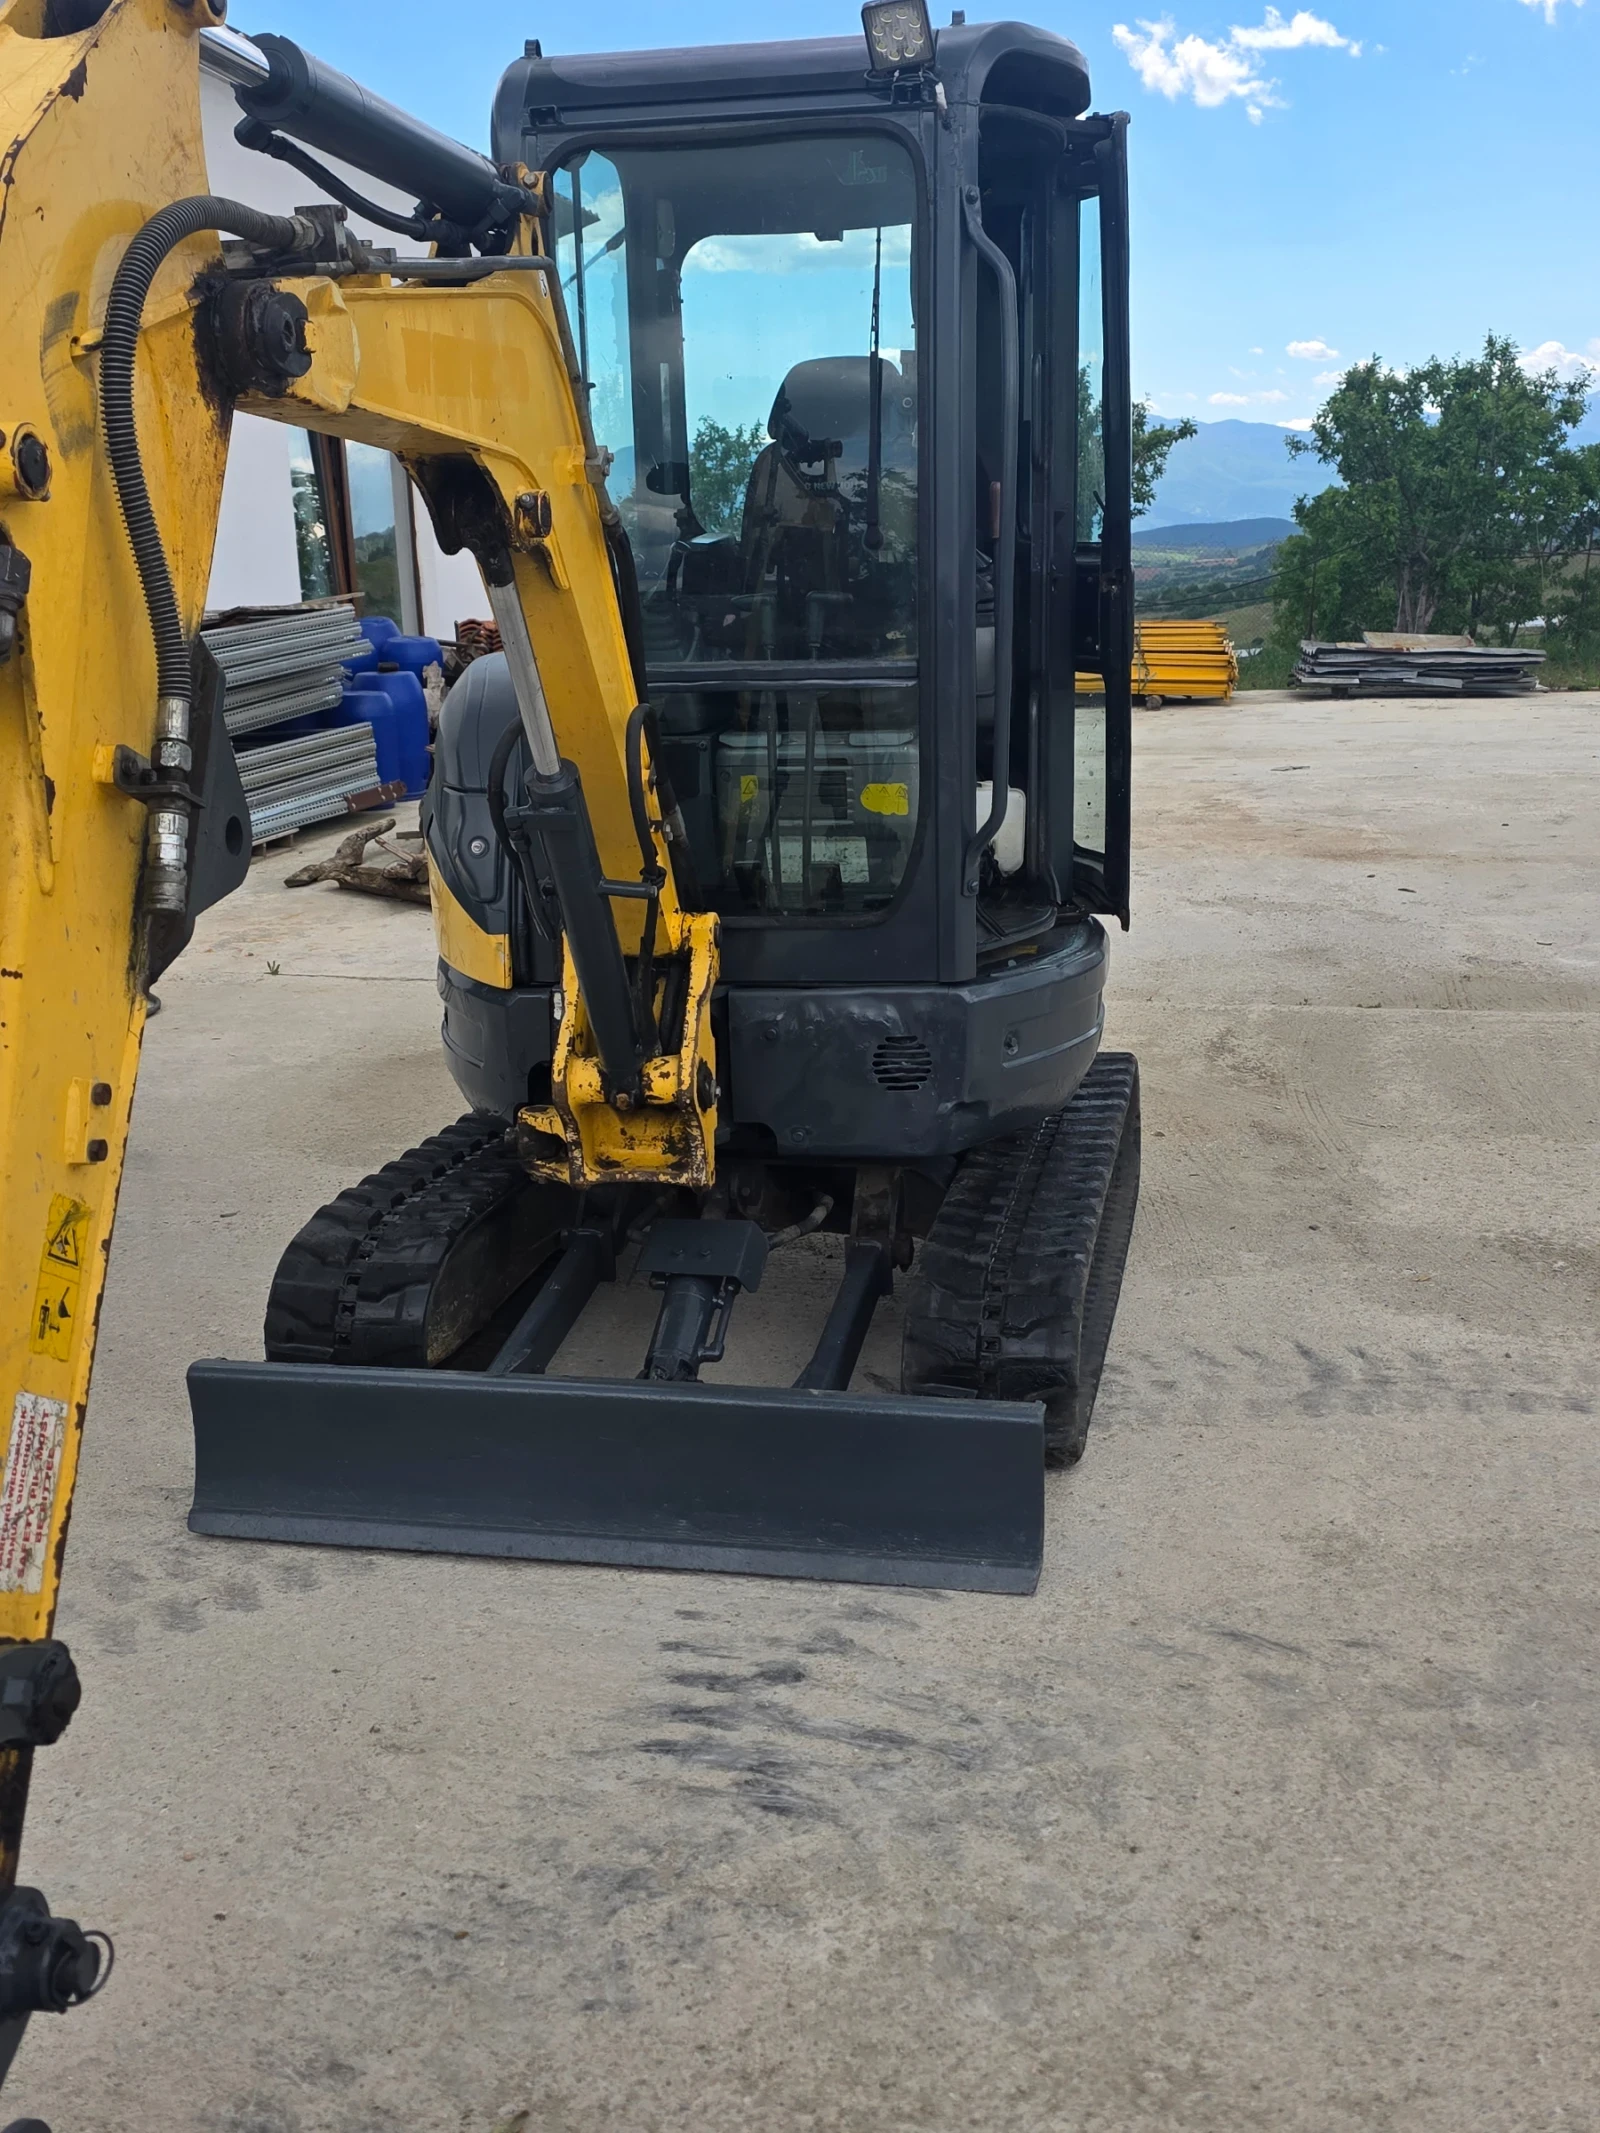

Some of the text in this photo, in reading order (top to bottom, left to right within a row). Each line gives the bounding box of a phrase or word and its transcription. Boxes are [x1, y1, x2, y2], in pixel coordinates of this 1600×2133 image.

[8, 1408, 27, 1499] WEDGELOCK
[34, 1446, 55, 1543] BE FITTED
[5, 1508, 21, 1569] MANUAL
[16, 1505, 34, 1579] SAFETY
